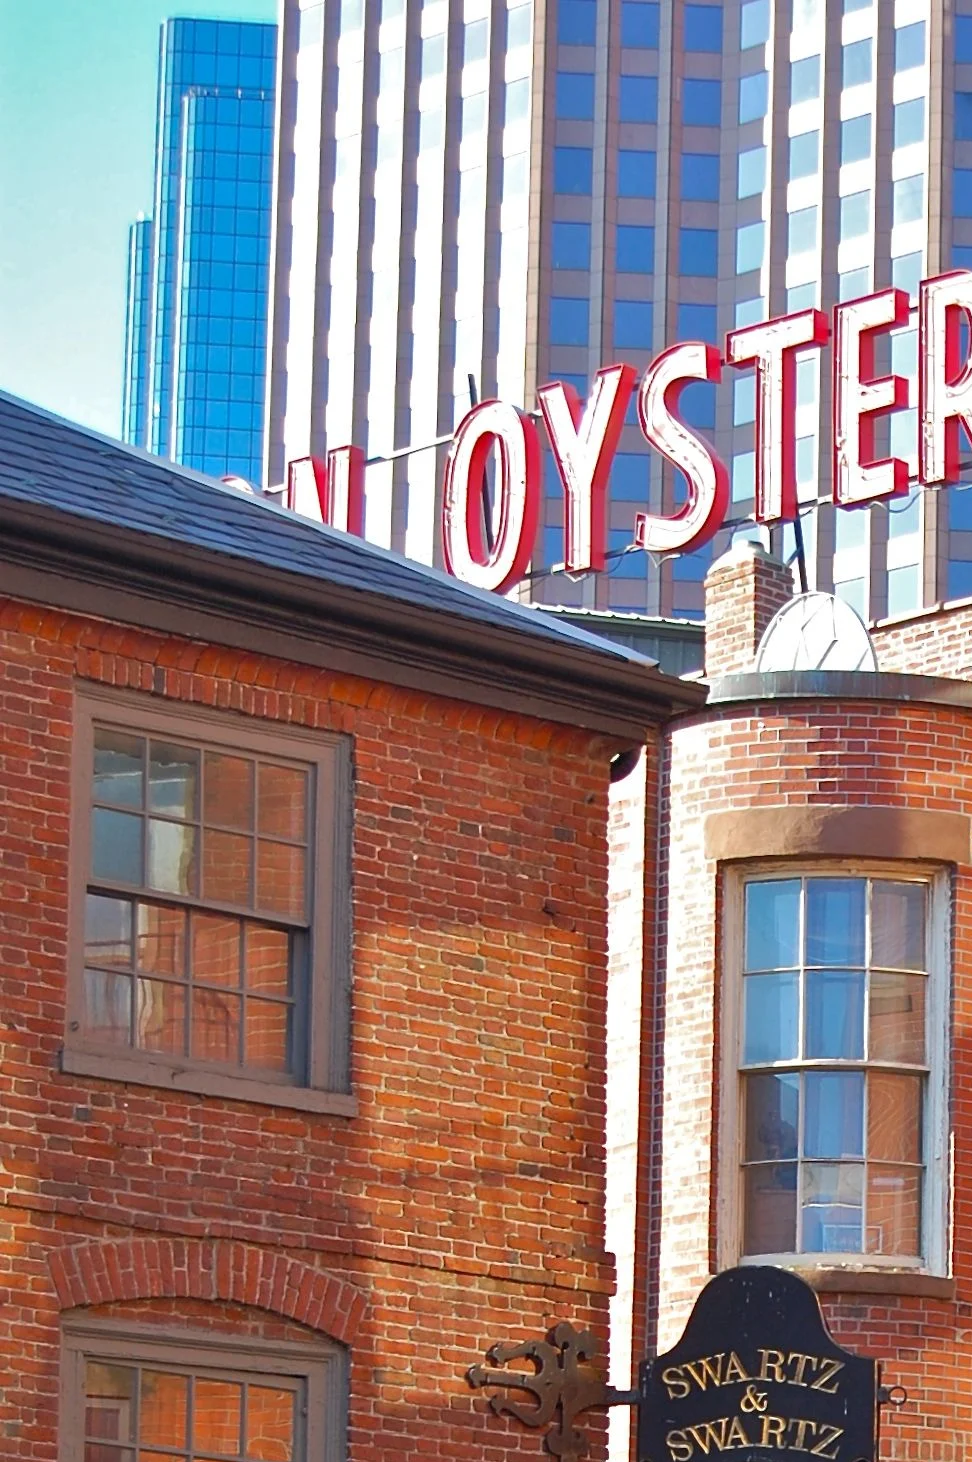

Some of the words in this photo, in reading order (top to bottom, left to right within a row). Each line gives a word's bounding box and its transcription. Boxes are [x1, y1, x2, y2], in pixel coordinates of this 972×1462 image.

[661, 1348, 847, 1400] SWARTZ
[739, 1384, 769, 1414] &
[665, 1415, 846, 1462] SWARTZ
